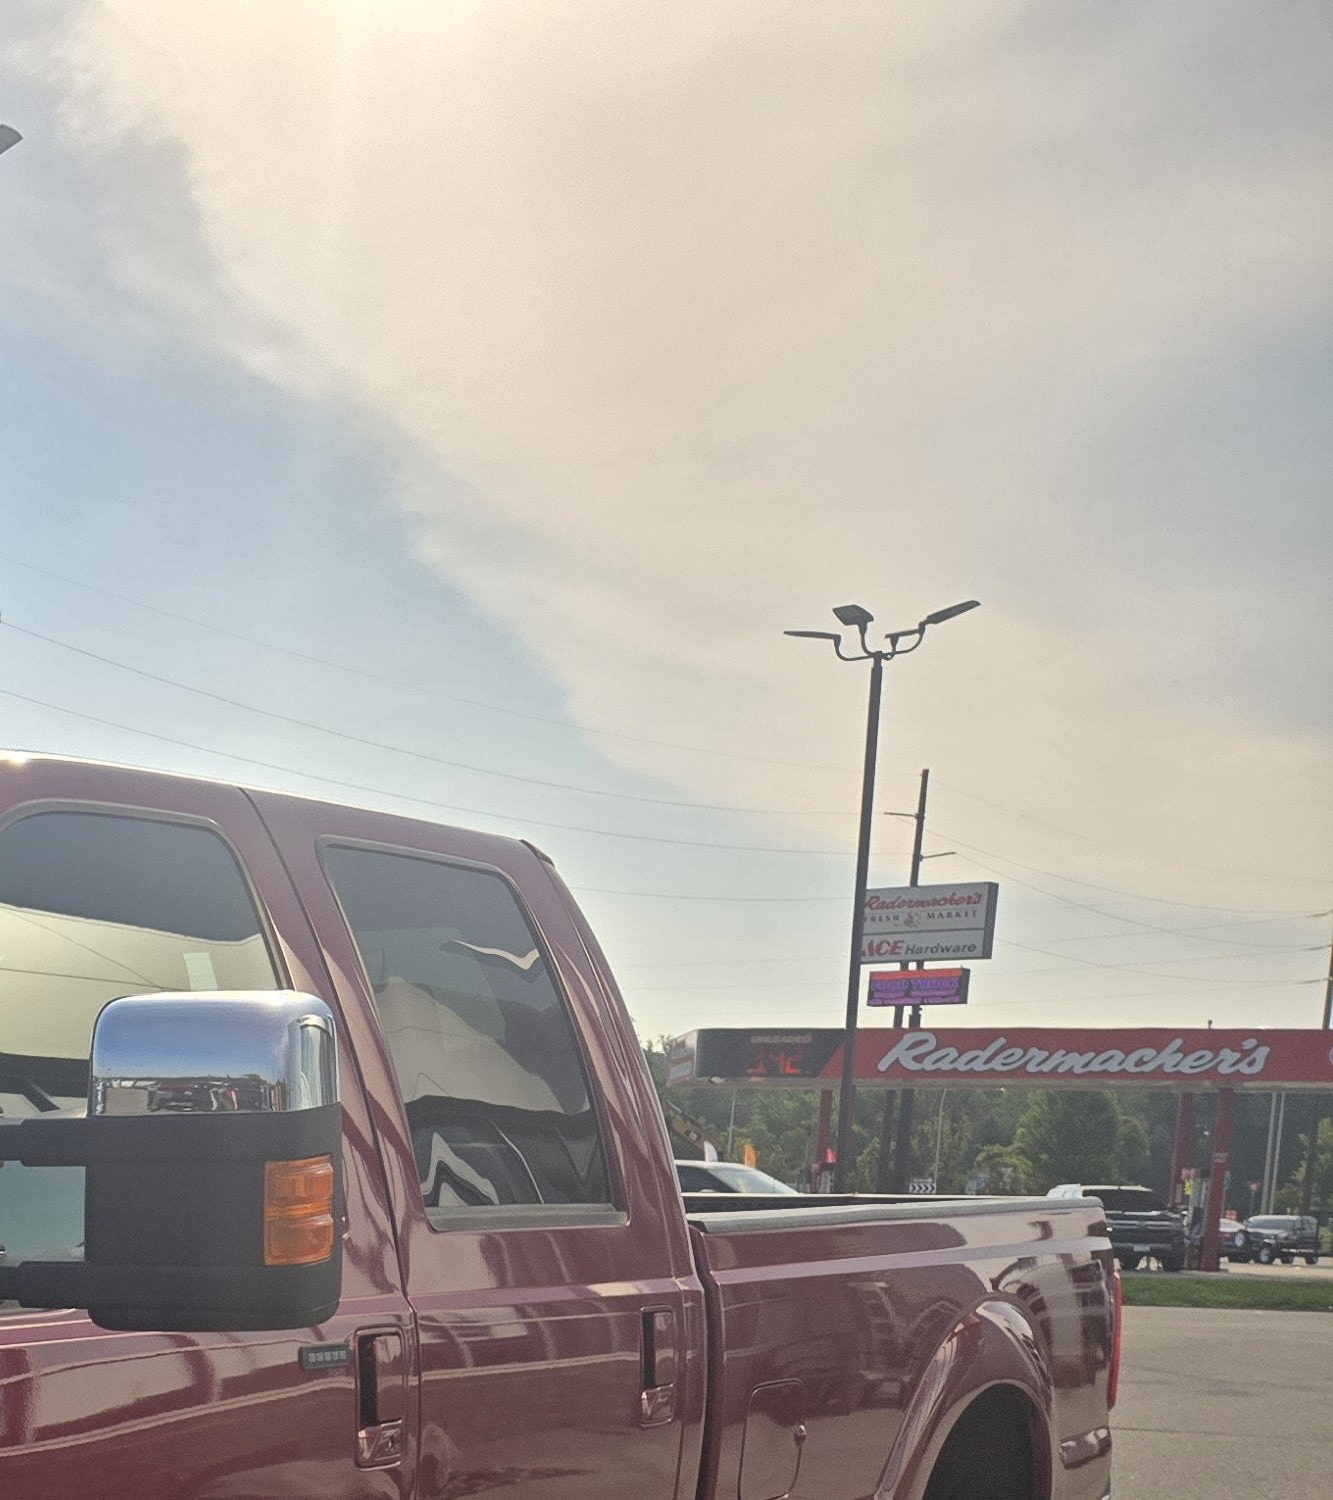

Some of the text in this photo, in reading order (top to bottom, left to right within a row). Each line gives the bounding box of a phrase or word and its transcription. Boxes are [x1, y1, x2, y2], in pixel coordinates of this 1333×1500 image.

[864, 910, 977, 922] RESH MARKET
[862, 938, 977, 957] ACE Hardware
[877, 1031, 1271, 1075] Radermacher's
